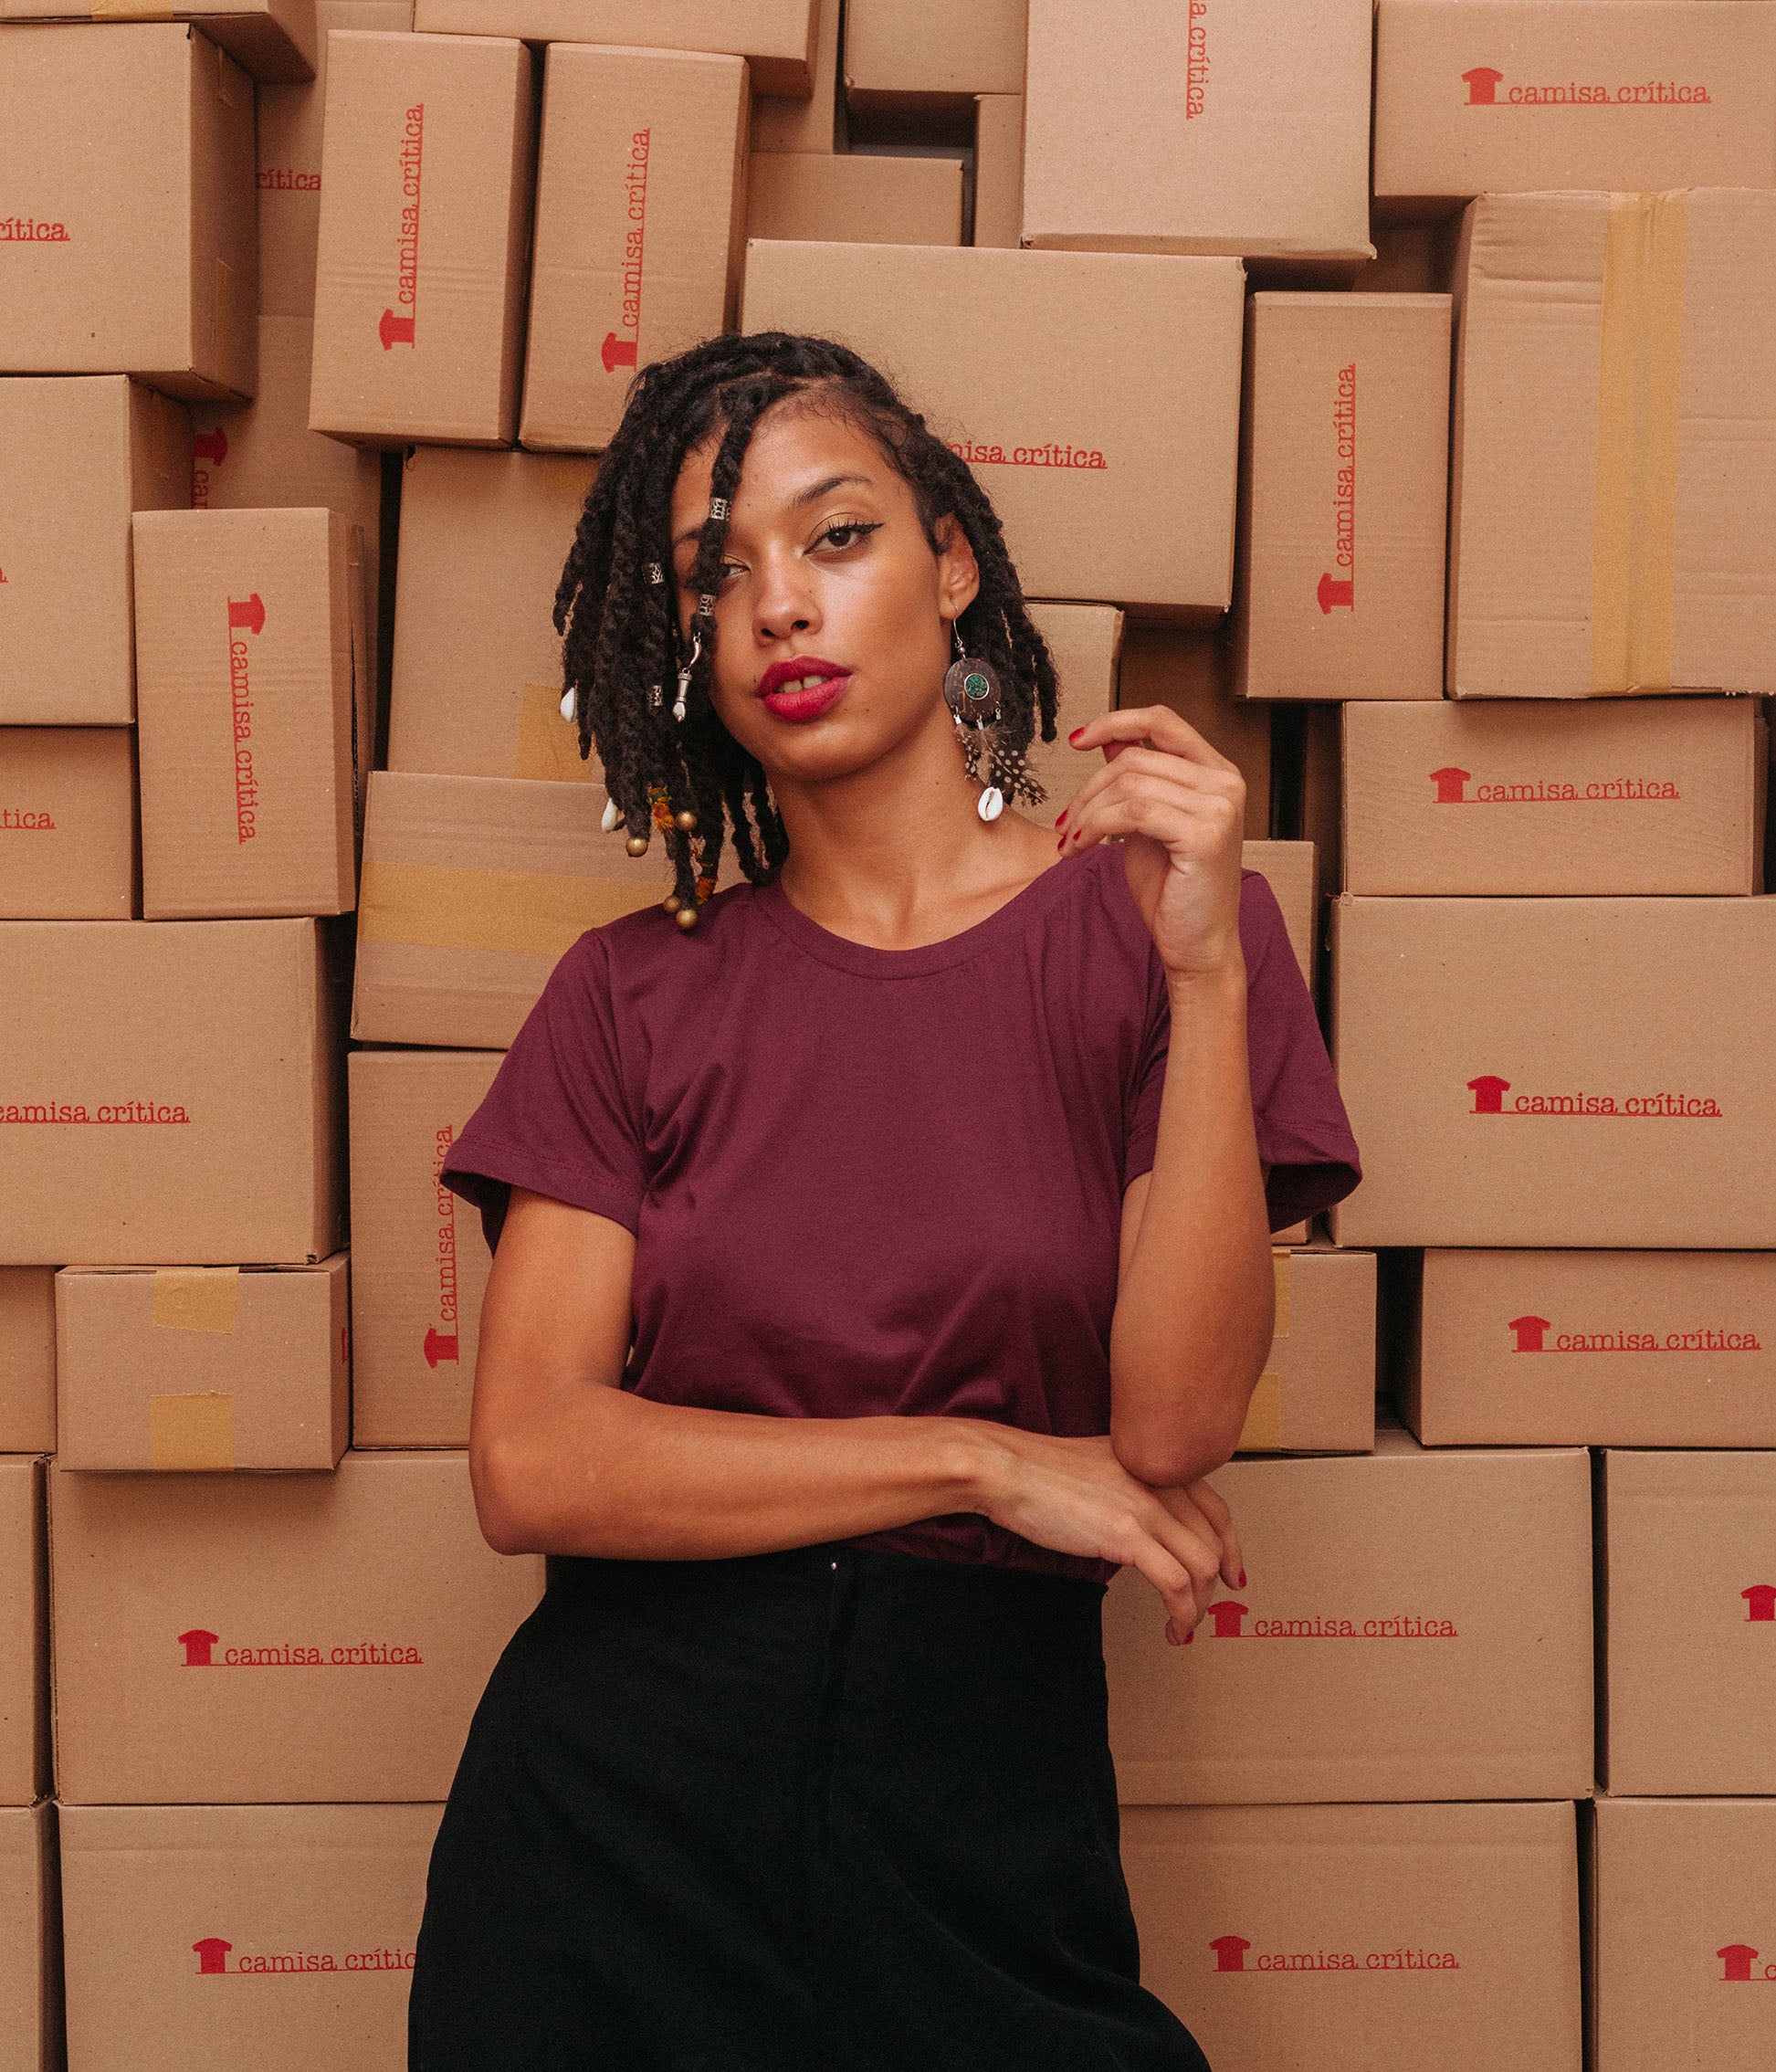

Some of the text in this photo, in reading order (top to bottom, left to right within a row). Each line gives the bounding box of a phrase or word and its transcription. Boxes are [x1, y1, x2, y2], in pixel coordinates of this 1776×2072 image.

[1186, 24, 1210, 120] crítica
[1508, 81, 1712, 105] camisa crítica
[256, 169, 321, 191] rítica
[396, 103, 424, 307] camisa crítica
[0, 217, 71, 242] ítica
[621, 129, 651, 330] camisa crítica
[1011, 443, 1108, 470] crítica
[1332, 363, 1356, 569] camisa crítica
[229, 639, 258, 845] camisa crítica
[1476, 778, 1680, 804] camisa crítica
[0, 809, 56, 830] tica
[0, 1100, 190, 1125] amisa crítica
[1513, 1092, 1723, 1118] camisa crítica
[436, 1222, 458, 1323] camisa
[1554, 1330, 1762, 1352] camisa crítica
[1253, 1615, 1458, 1638] camisa crítica
[223, 1643, 424, 1667] camisa crítica
[237, 1948, 416, 1974] camisa crític
[1257, 1949, 1460, 1972] camisa crítica
